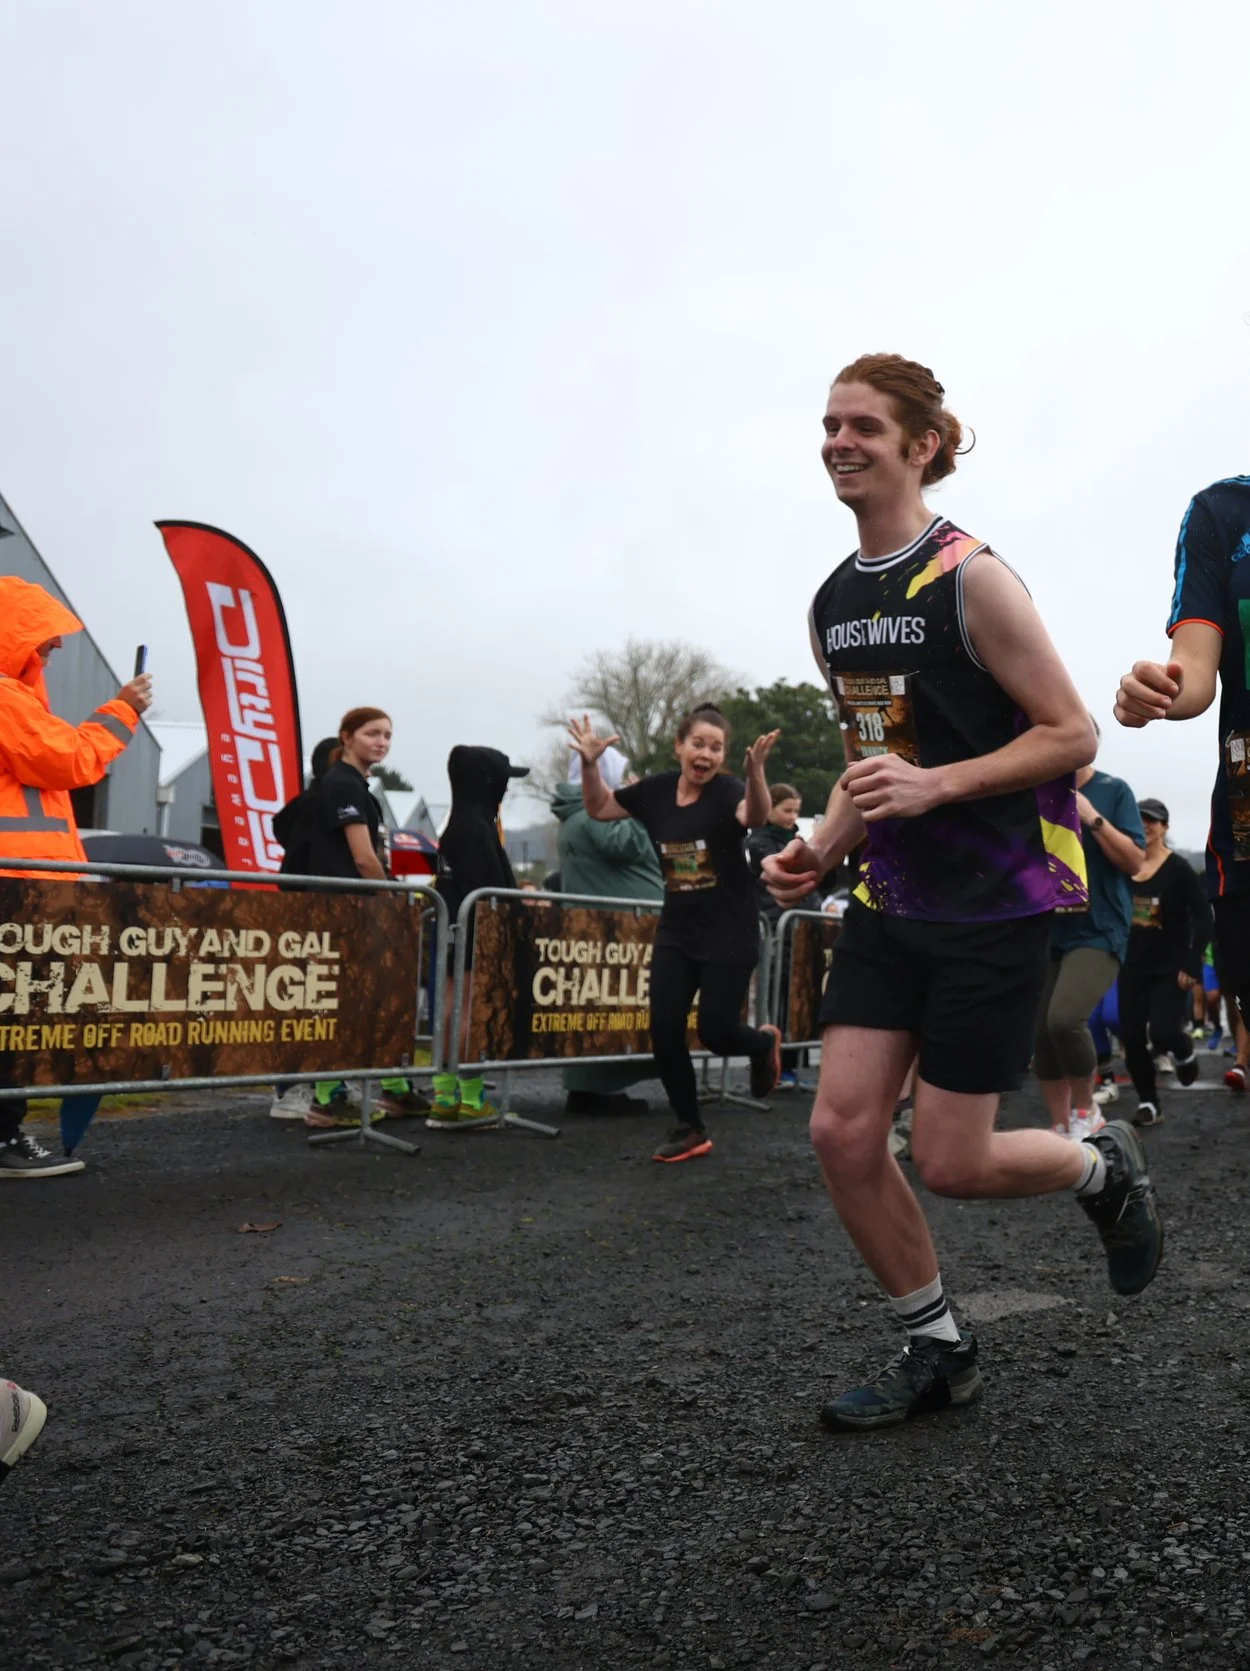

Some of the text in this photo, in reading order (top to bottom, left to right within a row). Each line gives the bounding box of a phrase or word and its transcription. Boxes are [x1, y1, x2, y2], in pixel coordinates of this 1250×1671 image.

[856, 712, 884, 742] 318
[119, 926, 198, 957] GUY
[199, 928, 271, 958] AND
[278, 931, 340, 959] GAL
[535, 938, 602, 964] TOUGH
[605, 942, 642, 965] GUY
[532, 966, 652, 1007] CHALLE
[0, 1018, 338, 1051] TREME OFF ROAD RUNNING EVENT
[532, 1012, 586, 1033] EXTREME
[586, 1013, 608, 1031] OFF
